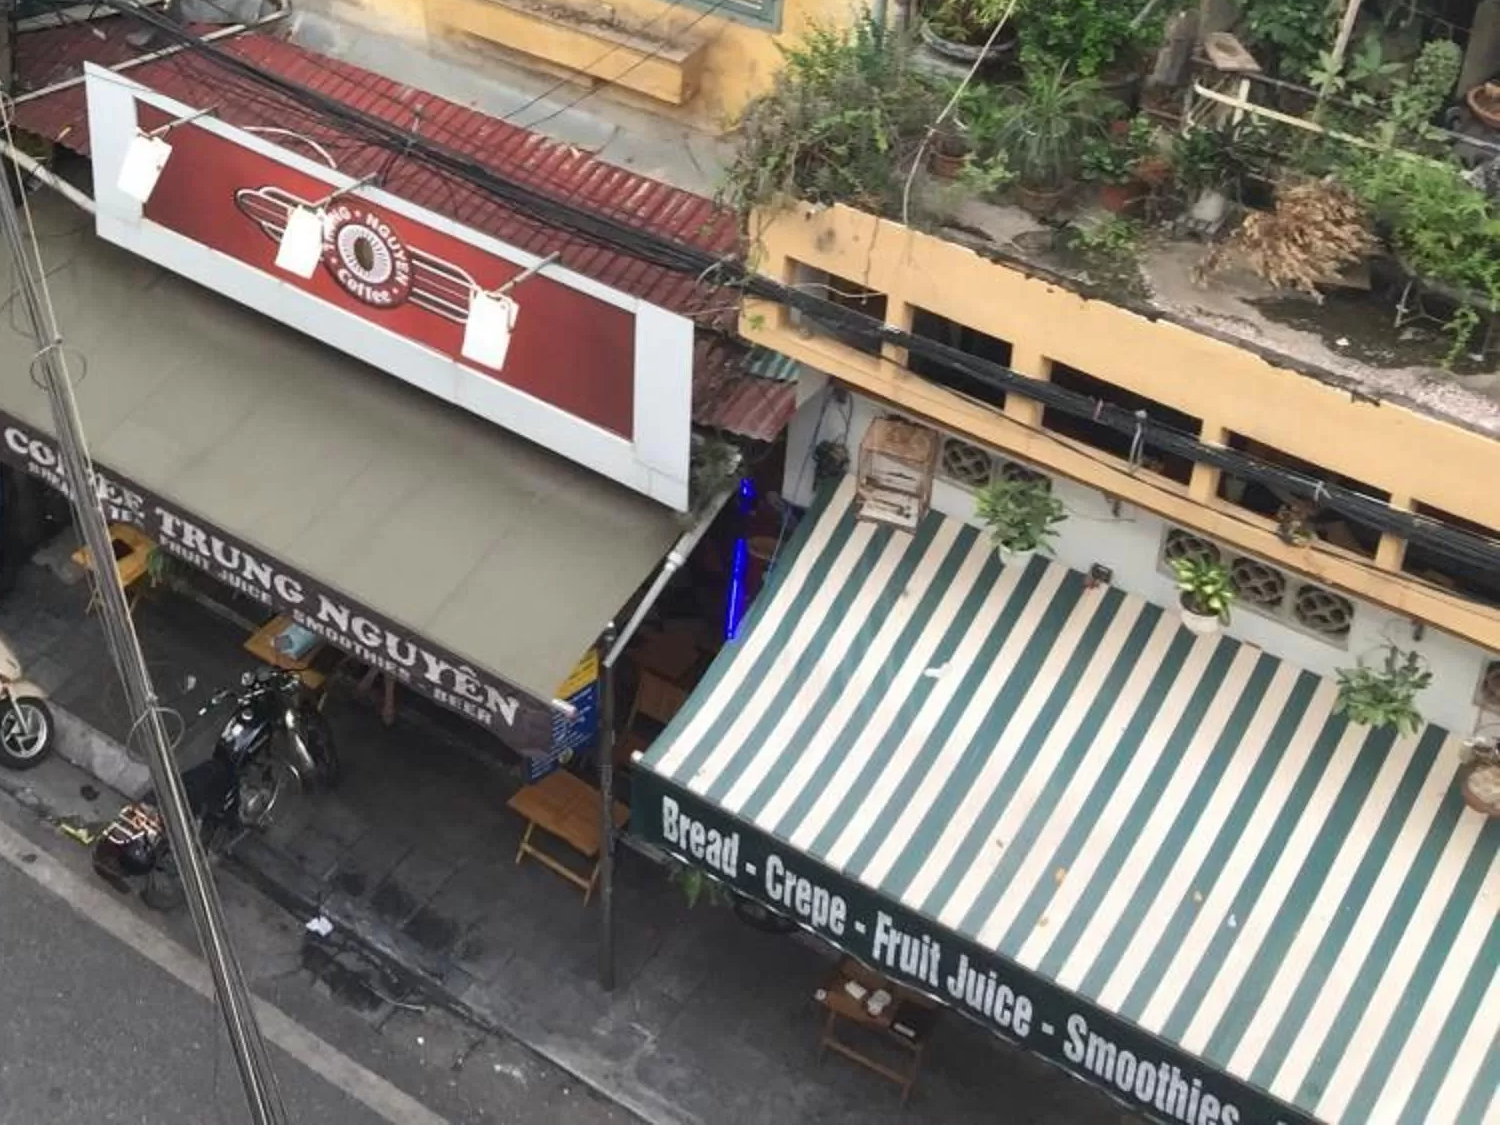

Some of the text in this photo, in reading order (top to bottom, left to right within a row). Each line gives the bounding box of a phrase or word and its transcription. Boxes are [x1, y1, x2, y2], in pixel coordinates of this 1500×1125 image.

[156, 506, 304, 604] TRUNG
[315, 594, 521, 727] NGUYÊN
[662, 795, 741, 878] Bread
[765, 853, 848, 937] Crepe
[872, 910, 942, 988] Fruit
[947, 954, 1034, 1038] Juice
[1063, 1013, 1241, 1125] Smoothies
